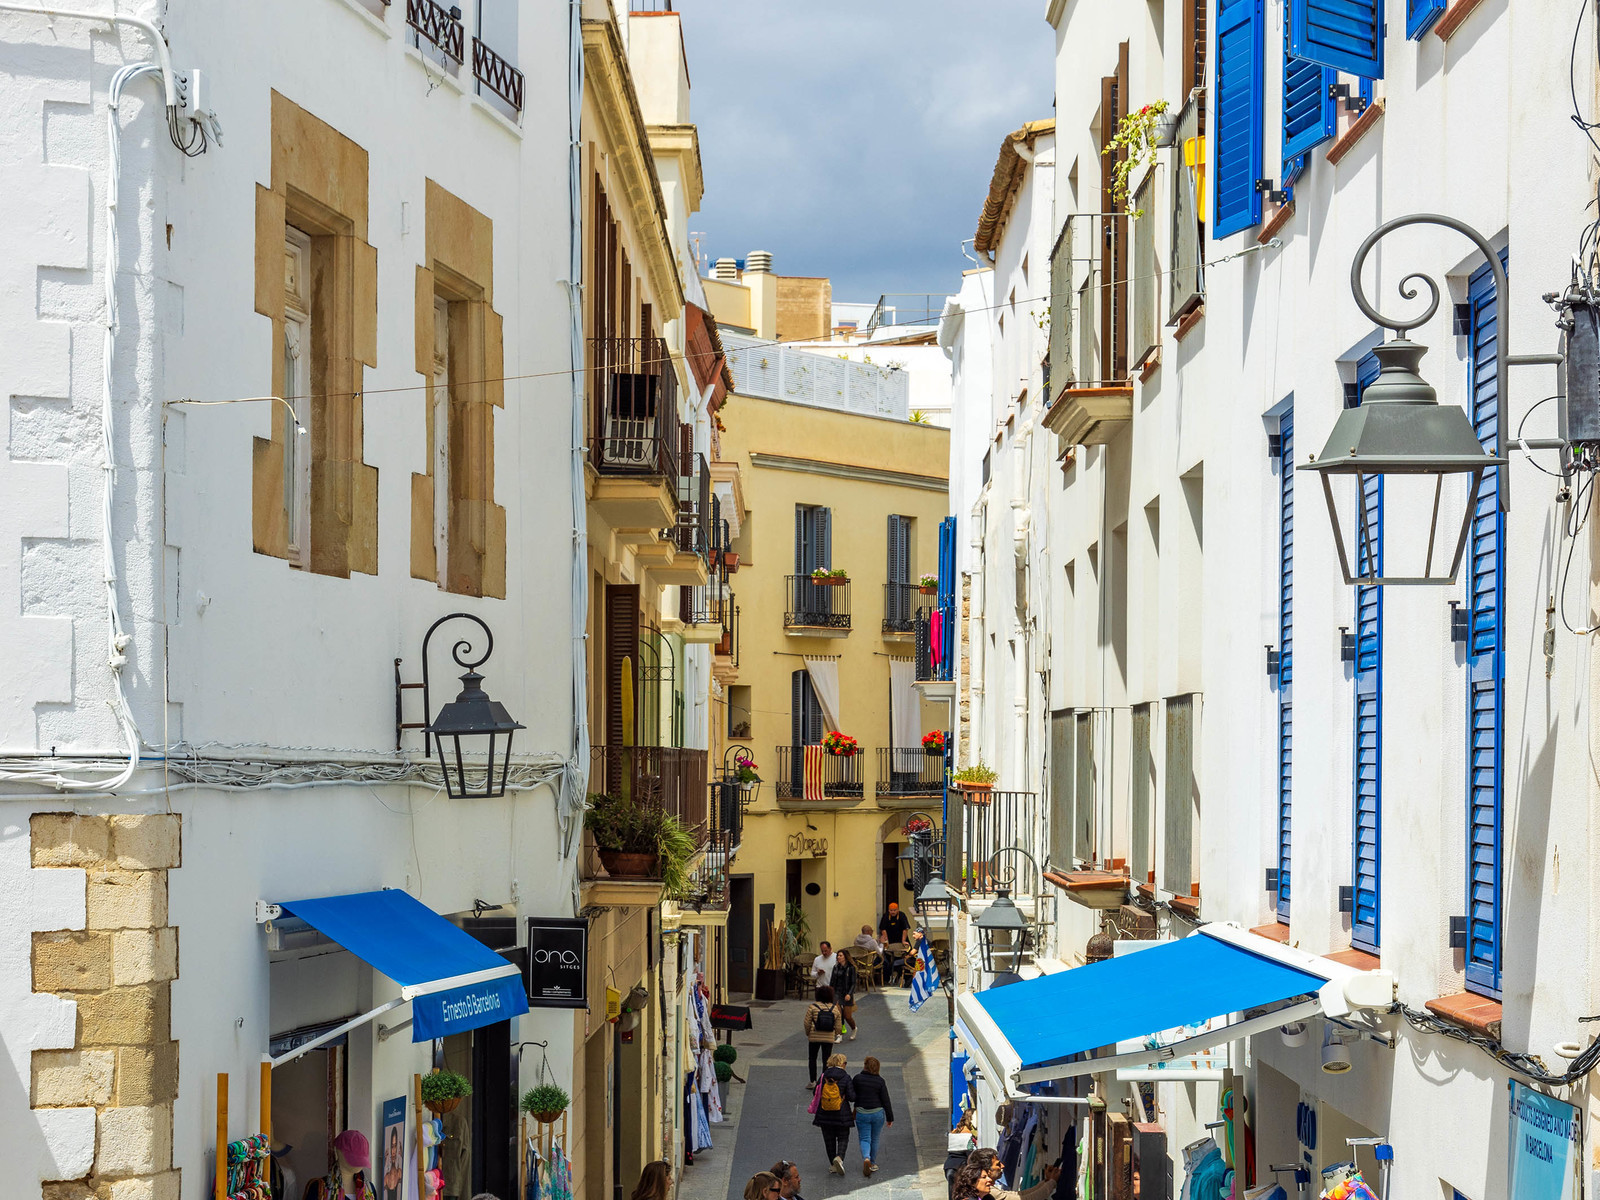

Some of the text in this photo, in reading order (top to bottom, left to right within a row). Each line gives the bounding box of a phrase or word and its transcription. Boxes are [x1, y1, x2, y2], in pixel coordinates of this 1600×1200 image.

[442, 999, 469, 1022] Ernesto
[471, 989, 501, 1015] Barcelona
[1533, 1107, 1553, 1133] DESIGNED
[1553, 1116, 1563, 1138] AND
[1564, 1119, 1577, 1143] MADE
[1529, 1135, 1553, 1164] BARCELONA
